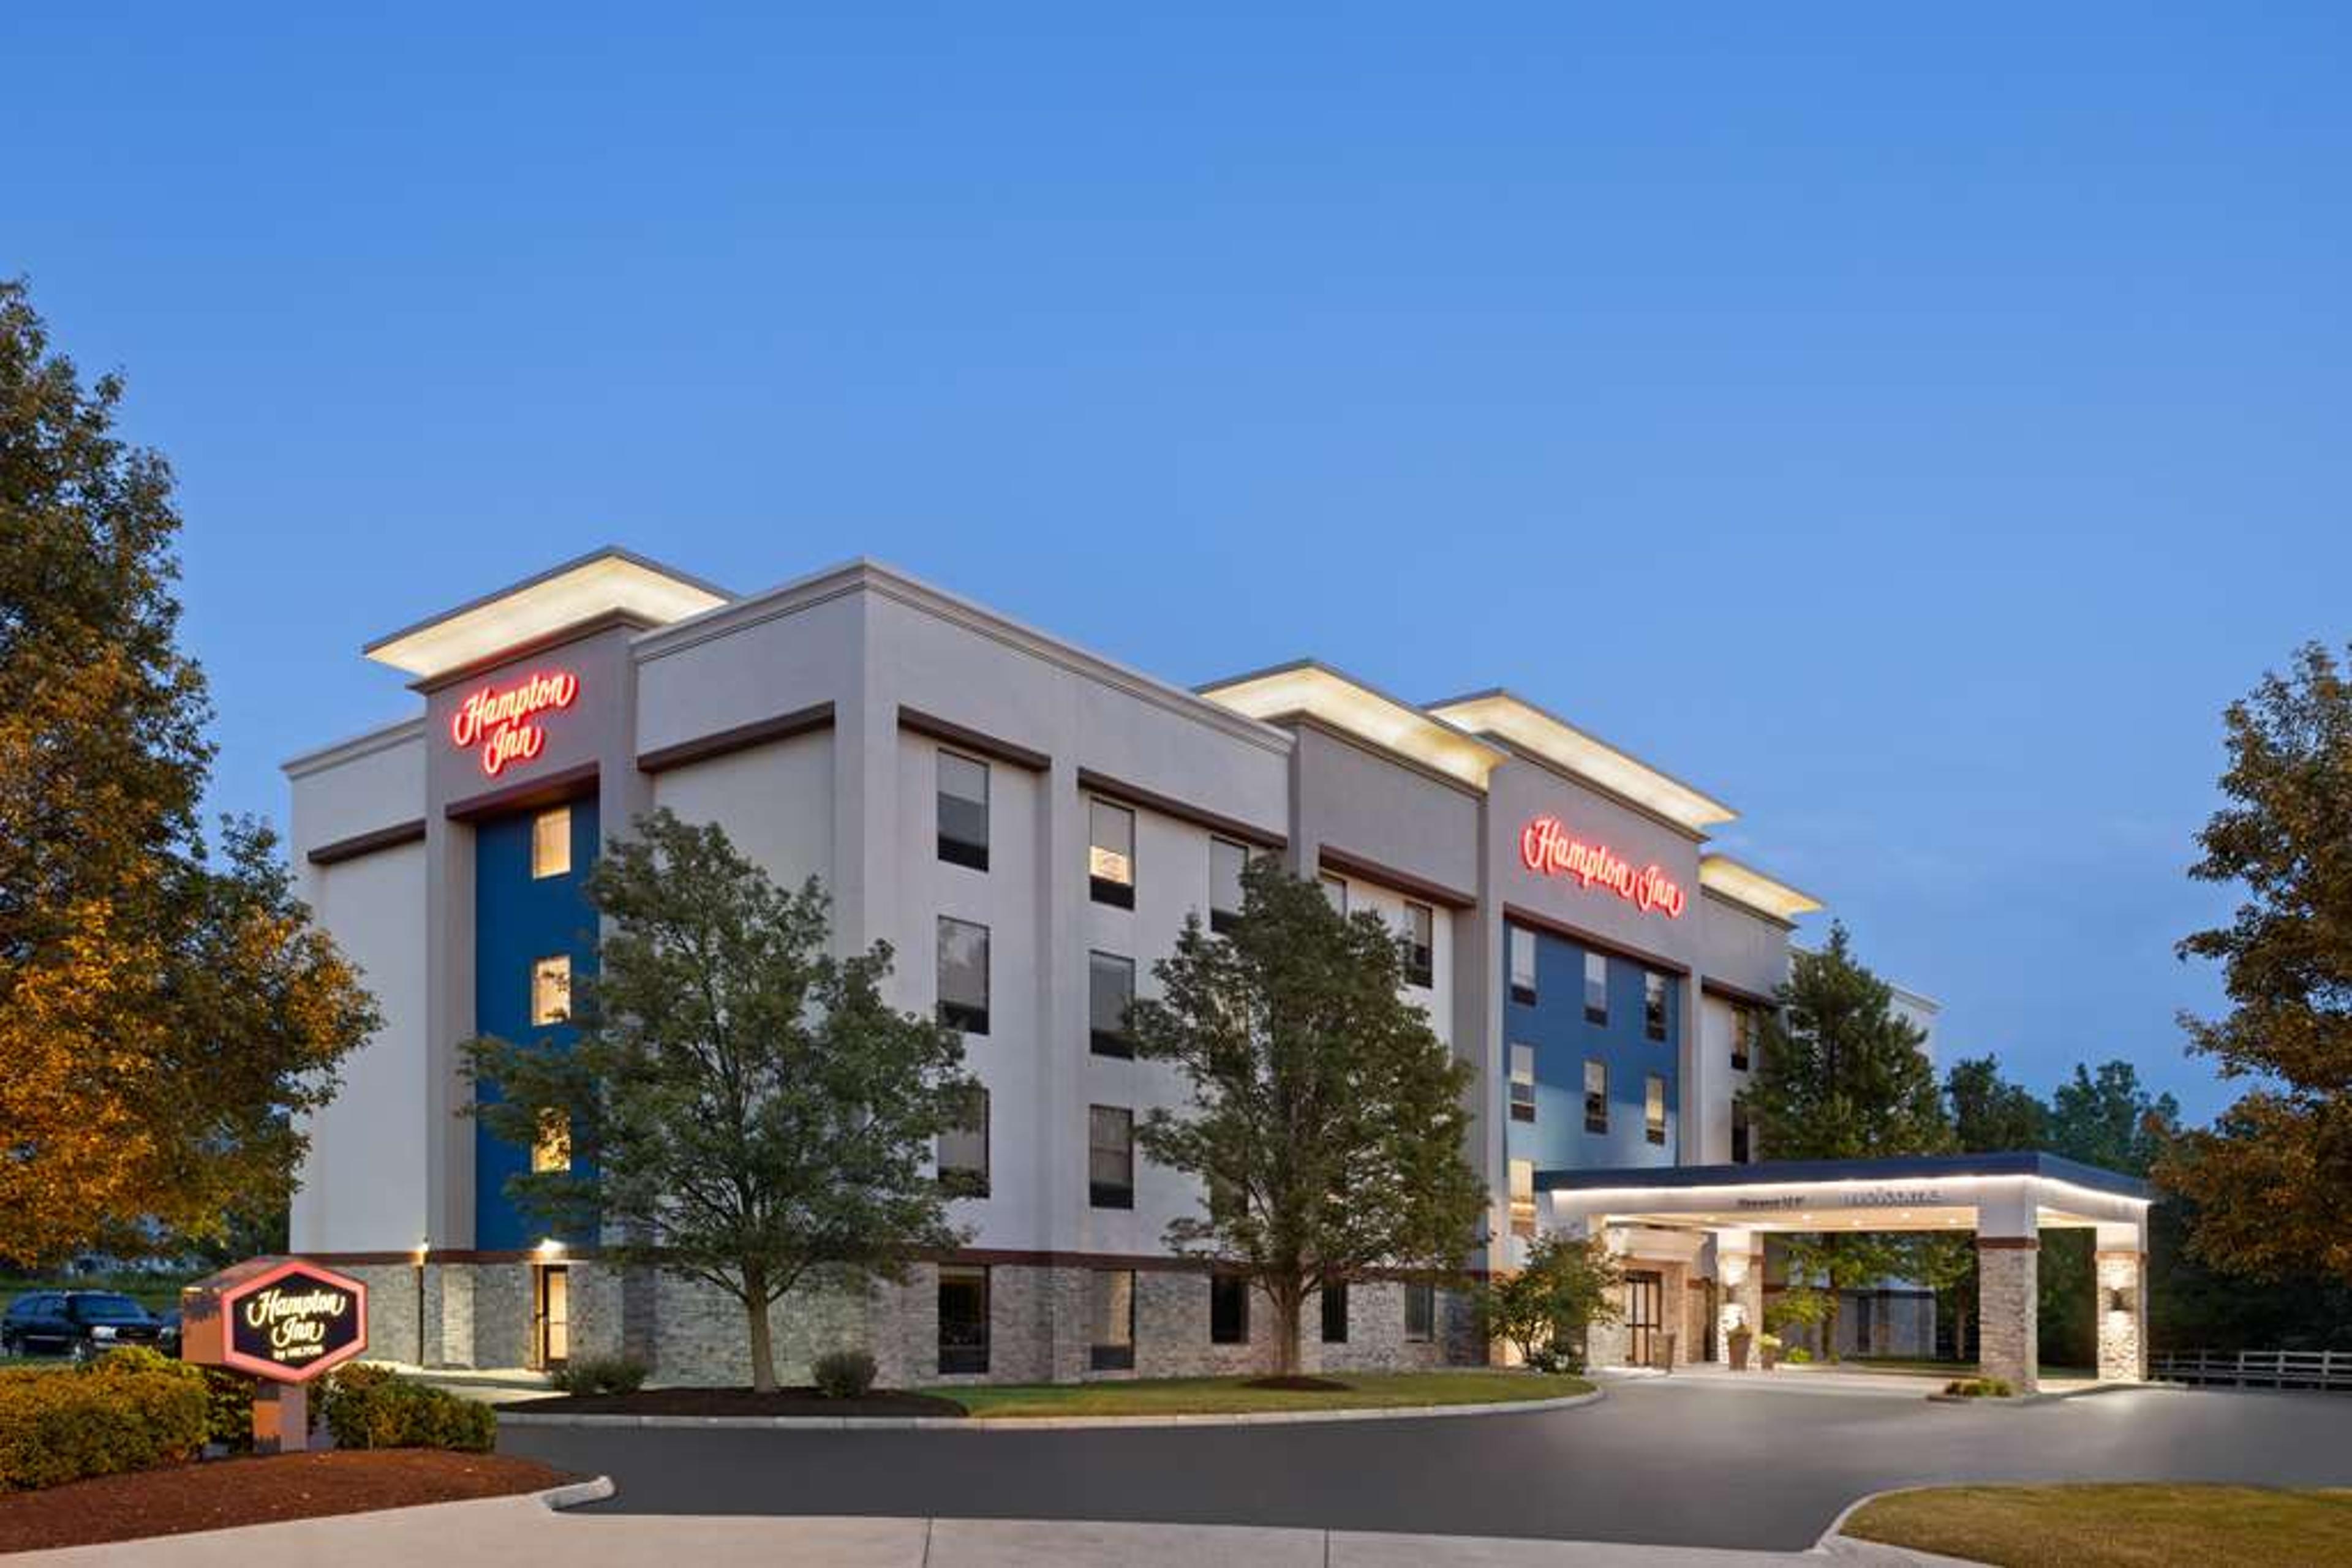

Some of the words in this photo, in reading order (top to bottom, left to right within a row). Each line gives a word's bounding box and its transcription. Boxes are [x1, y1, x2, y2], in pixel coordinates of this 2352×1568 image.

[453, 673, 578, 746] Hampton
[483, 721, 543, 774] Inn
[1523, 818, 1636, 897] Hampton
[1636, 864, 1684, 918] Inn
[247, 1288, 346, 1327] Hampton
[271, 1316, 325, 1348] Inn
